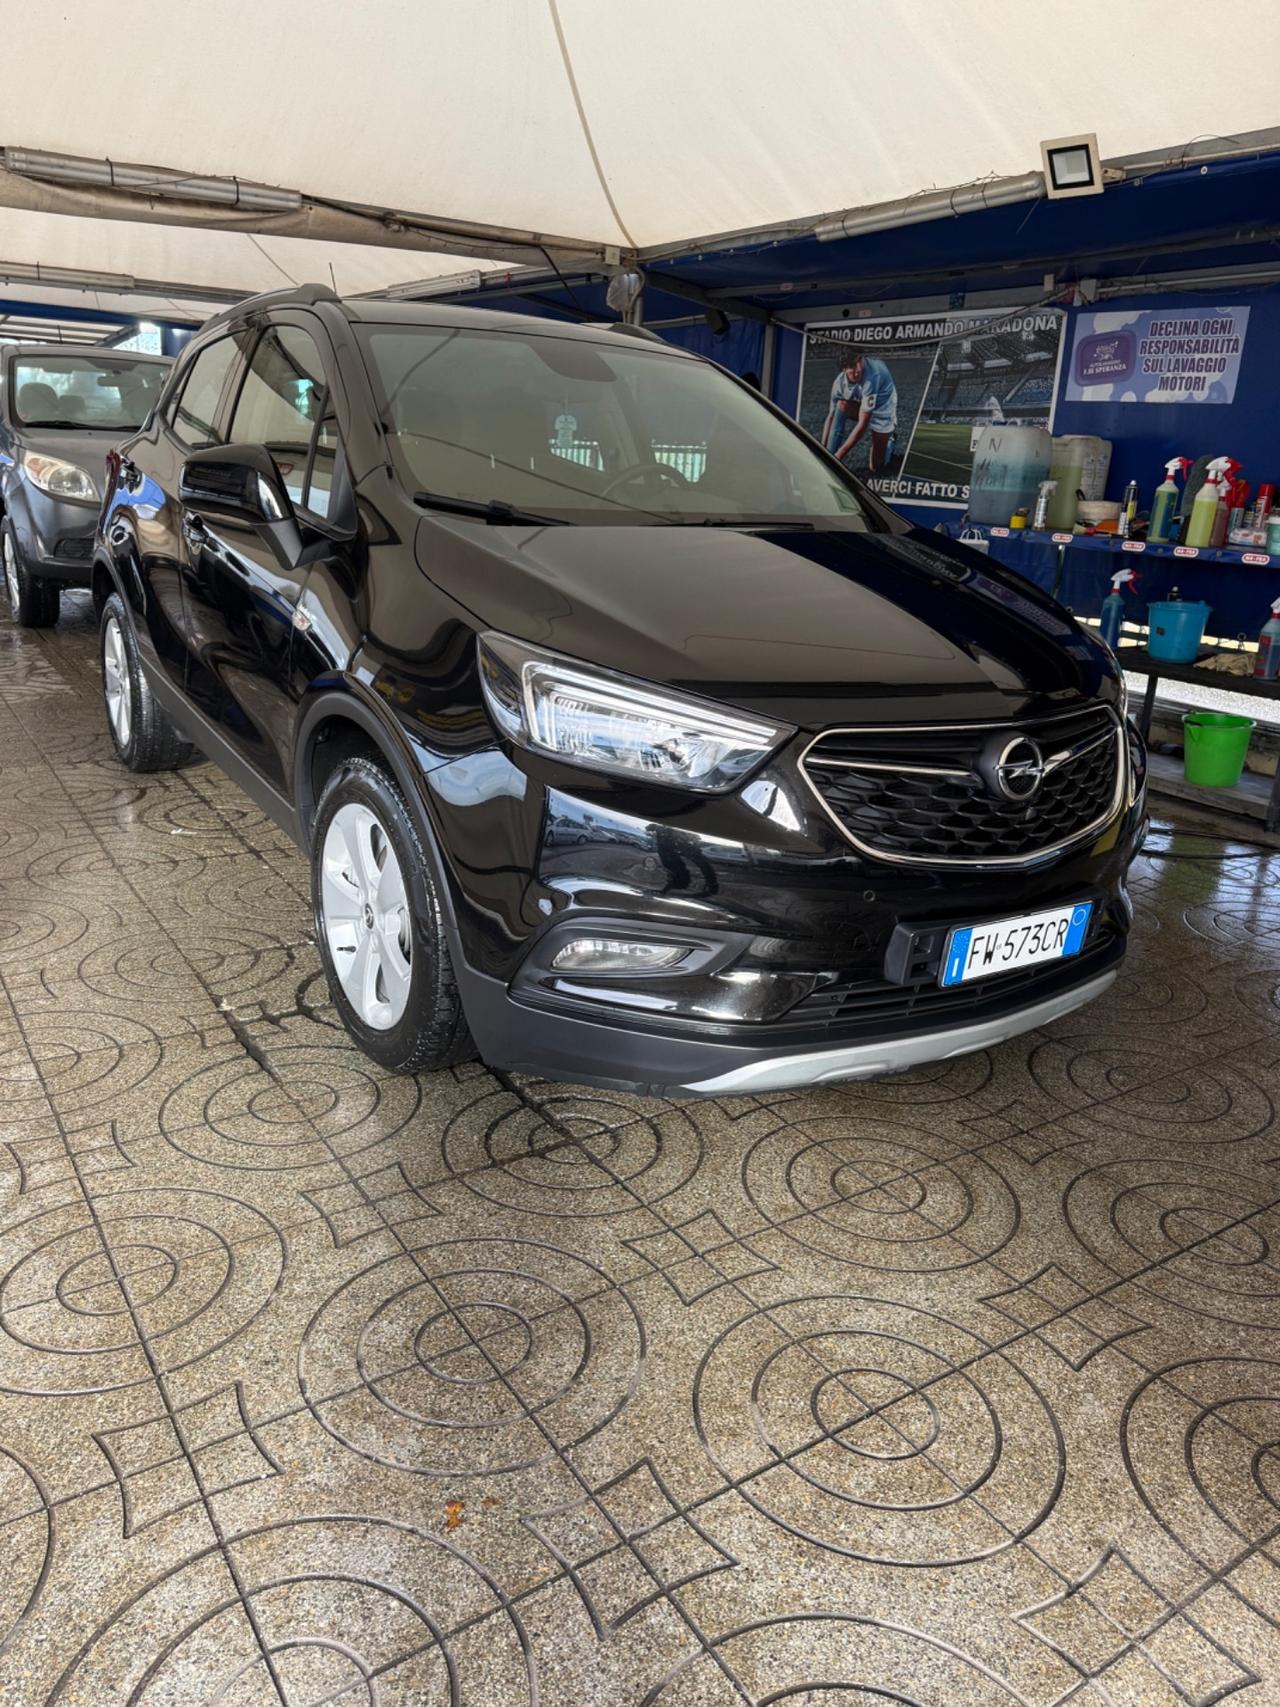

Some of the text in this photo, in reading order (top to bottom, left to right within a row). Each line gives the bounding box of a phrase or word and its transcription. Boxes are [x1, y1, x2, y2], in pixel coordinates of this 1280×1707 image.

[853, 326, 893, 342] DIEGO
[895, 320, 964, 339] ARMANDO
[1151, 319, 1234, 337] DECLINA OGNI
[1139, 336, 1240, 356] RESPONSABILITÀ
[1143, 357, 1227, 373] SUL LAVAGGIO
[1158, 376, 1207, 392] MOTORI
[866, 479, 912, 494] AVERCI
[915, 481, 957, 498] FATTO
[1002, 918, 1069, 961] 573CR
